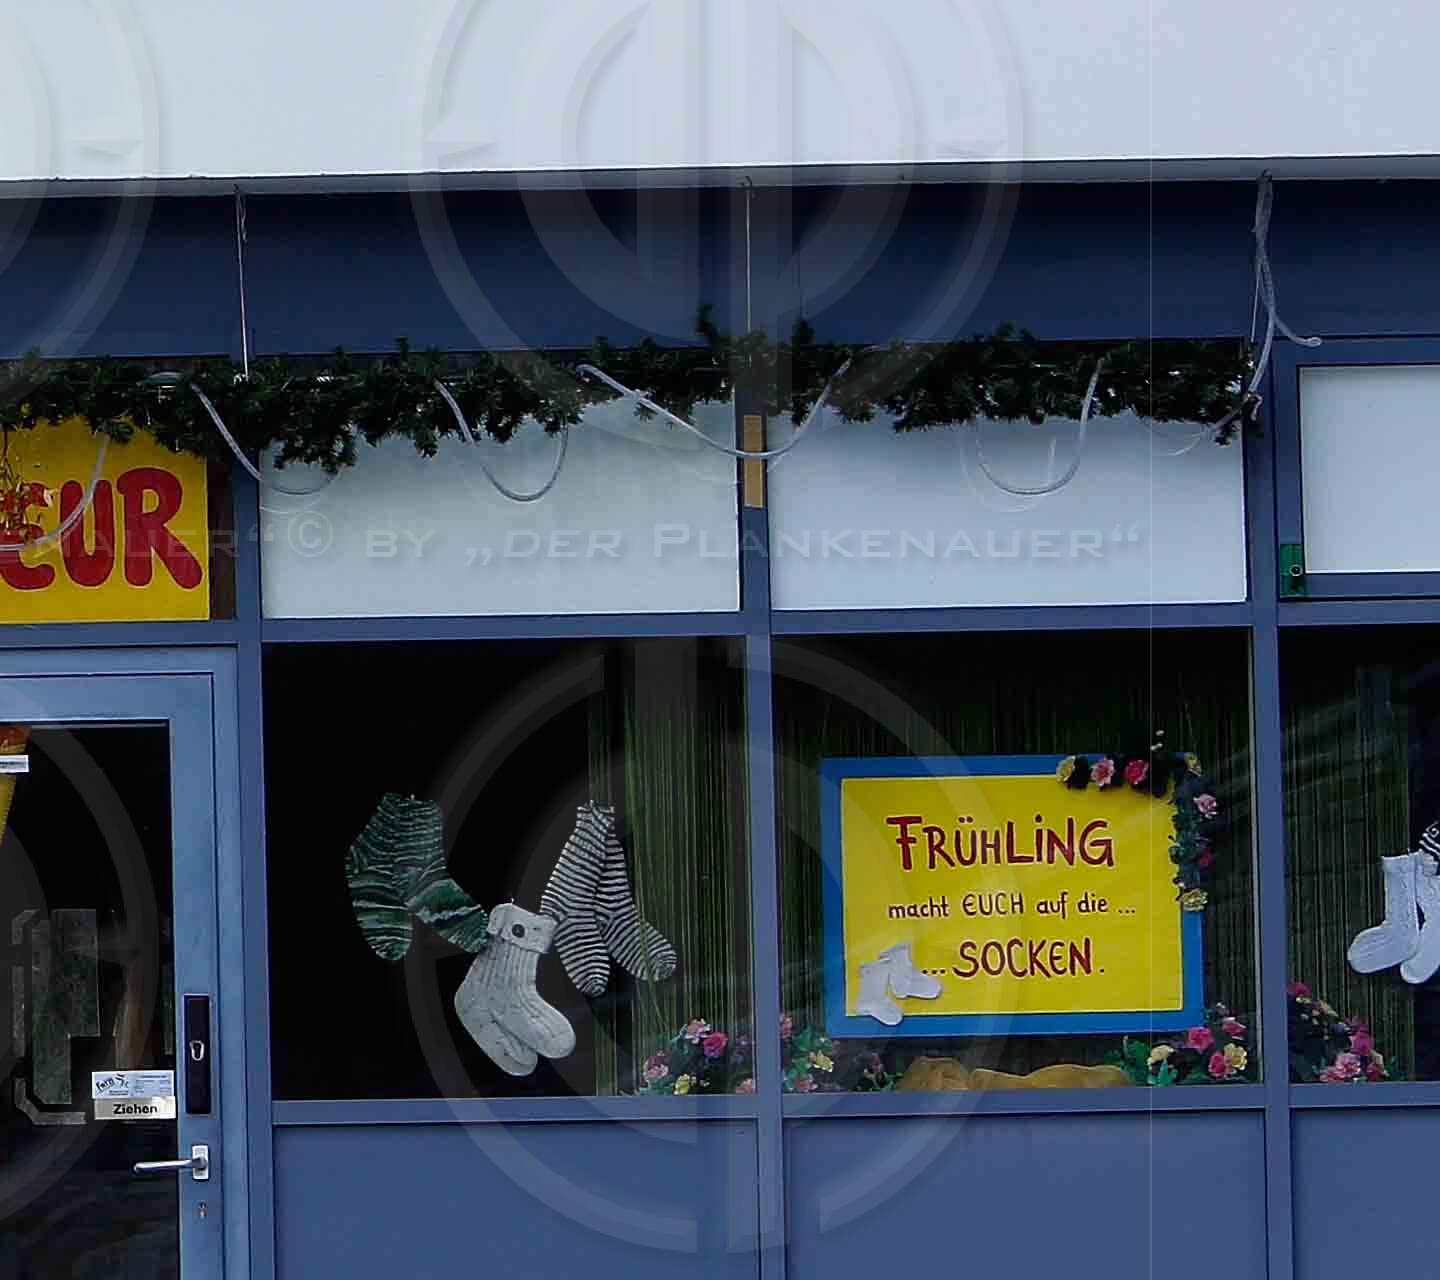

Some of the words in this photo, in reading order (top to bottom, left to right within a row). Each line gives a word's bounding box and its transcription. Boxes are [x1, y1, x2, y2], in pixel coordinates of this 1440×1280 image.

[888, 895, 949, 918] macht
[962, 891, 1024, 916] EUCH
[1036, 891, 1068, 919] auf
[1078, 892, 1108, 914] die
[113, 1103, 158, 1115] Ziehen
